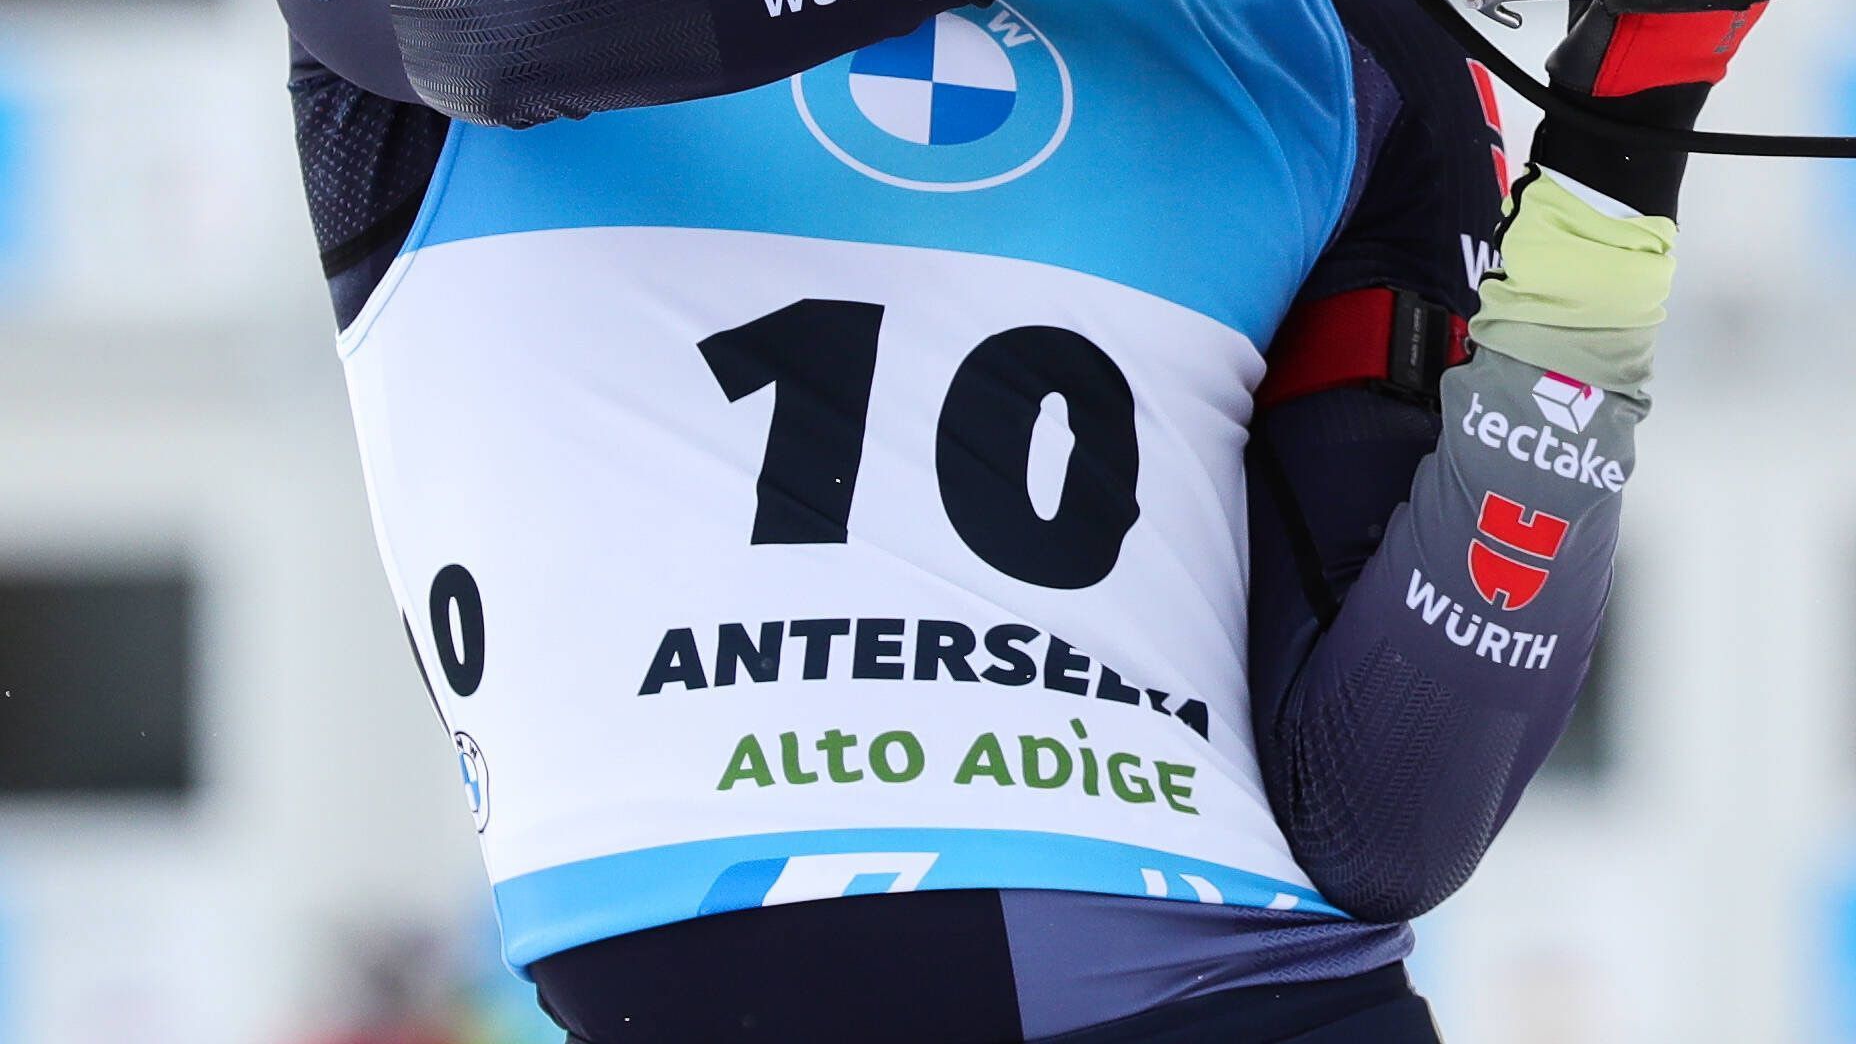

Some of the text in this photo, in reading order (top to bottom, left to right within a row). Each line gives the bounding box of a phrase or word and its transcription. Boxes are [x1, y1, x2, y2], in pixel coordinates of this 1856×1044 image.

[696, 297, 1140, 590] 10
[1462, 392, 1626, 493] tectake
[1405, 568, 1559, 670] WÜRTH
